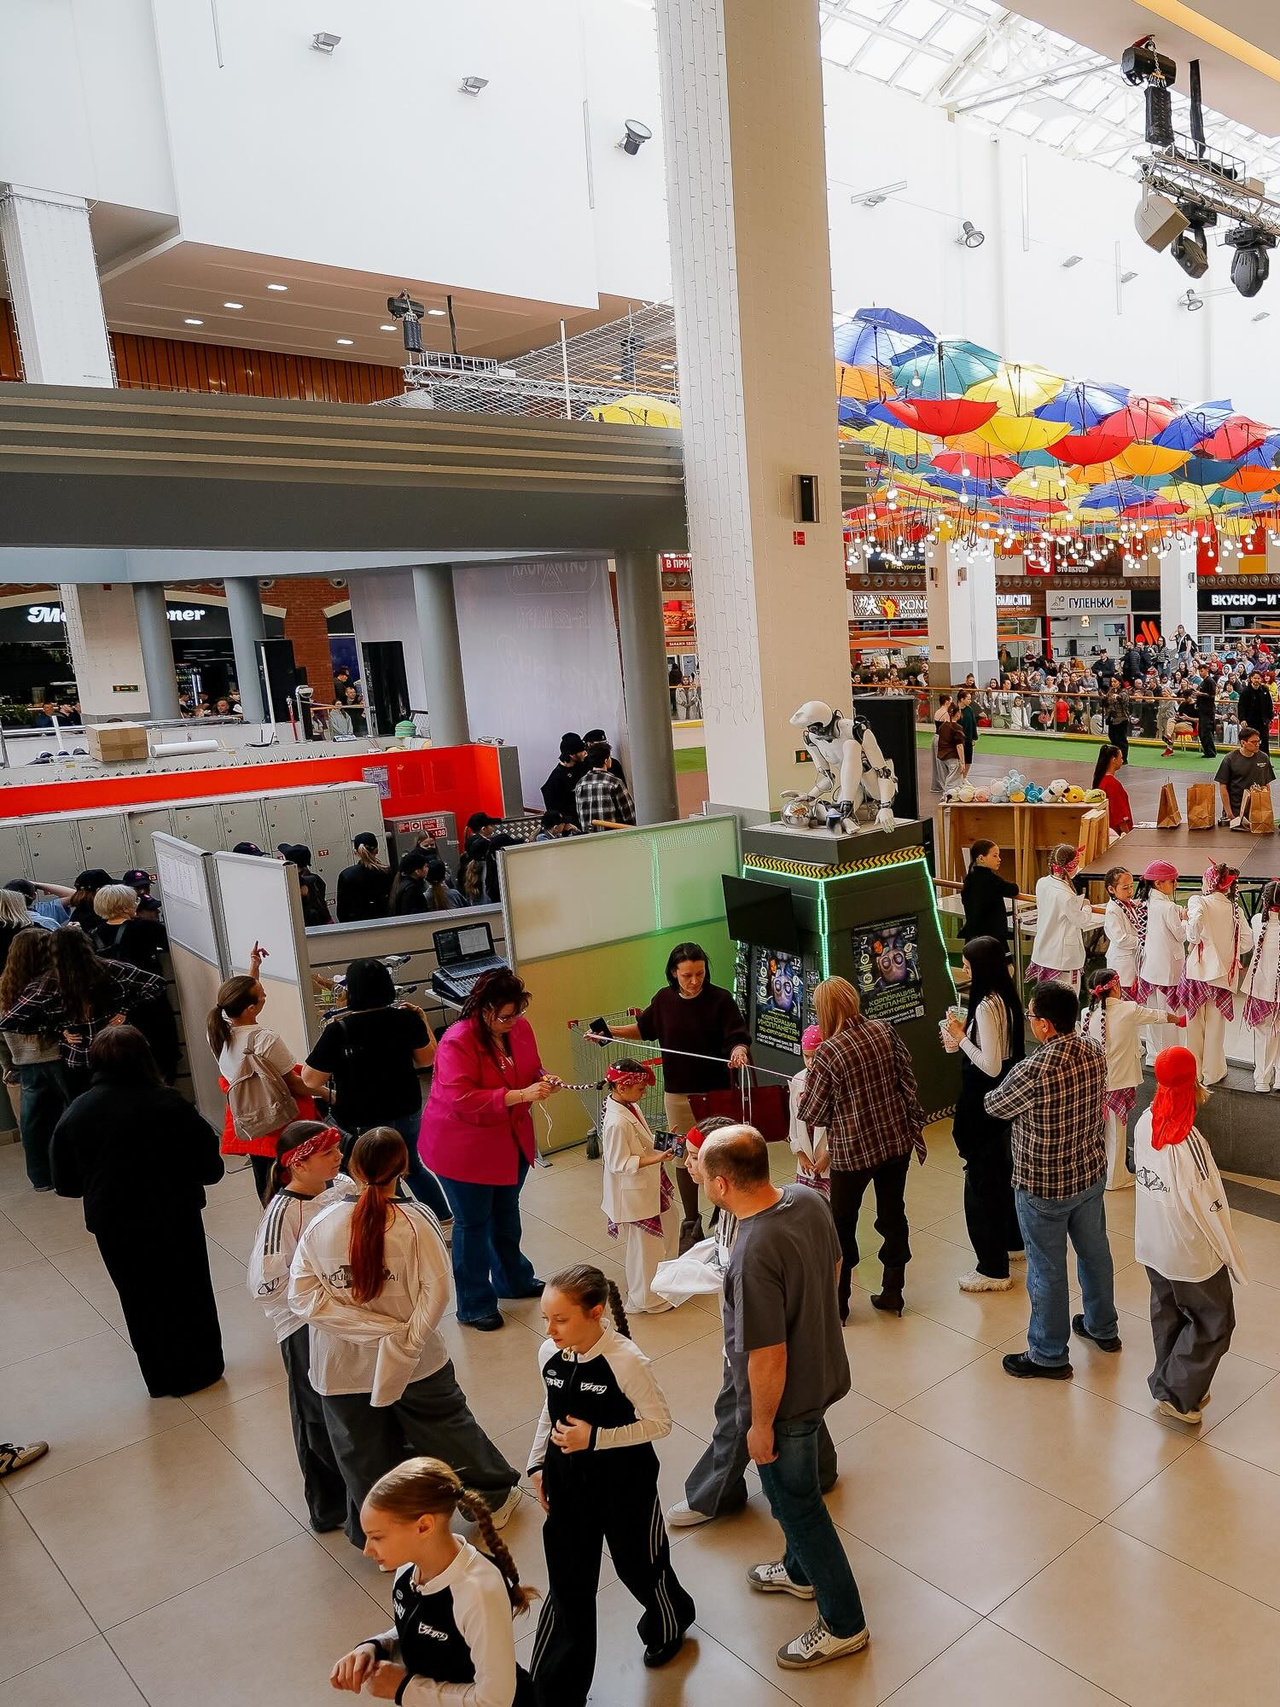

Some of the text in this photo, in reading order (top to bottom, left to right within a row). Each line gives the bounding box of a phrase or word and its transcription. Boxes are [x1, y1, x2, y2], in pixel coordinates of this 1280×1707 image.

[673, 559, 690, 569] ПРИ
[1068, 597, 1114, 609] ГУЛЕНЬКИ
[1211, 594, 1256, 606] ВКУСНО
[868, 987, 916, 1007] КОРПОРАЦИЯ
